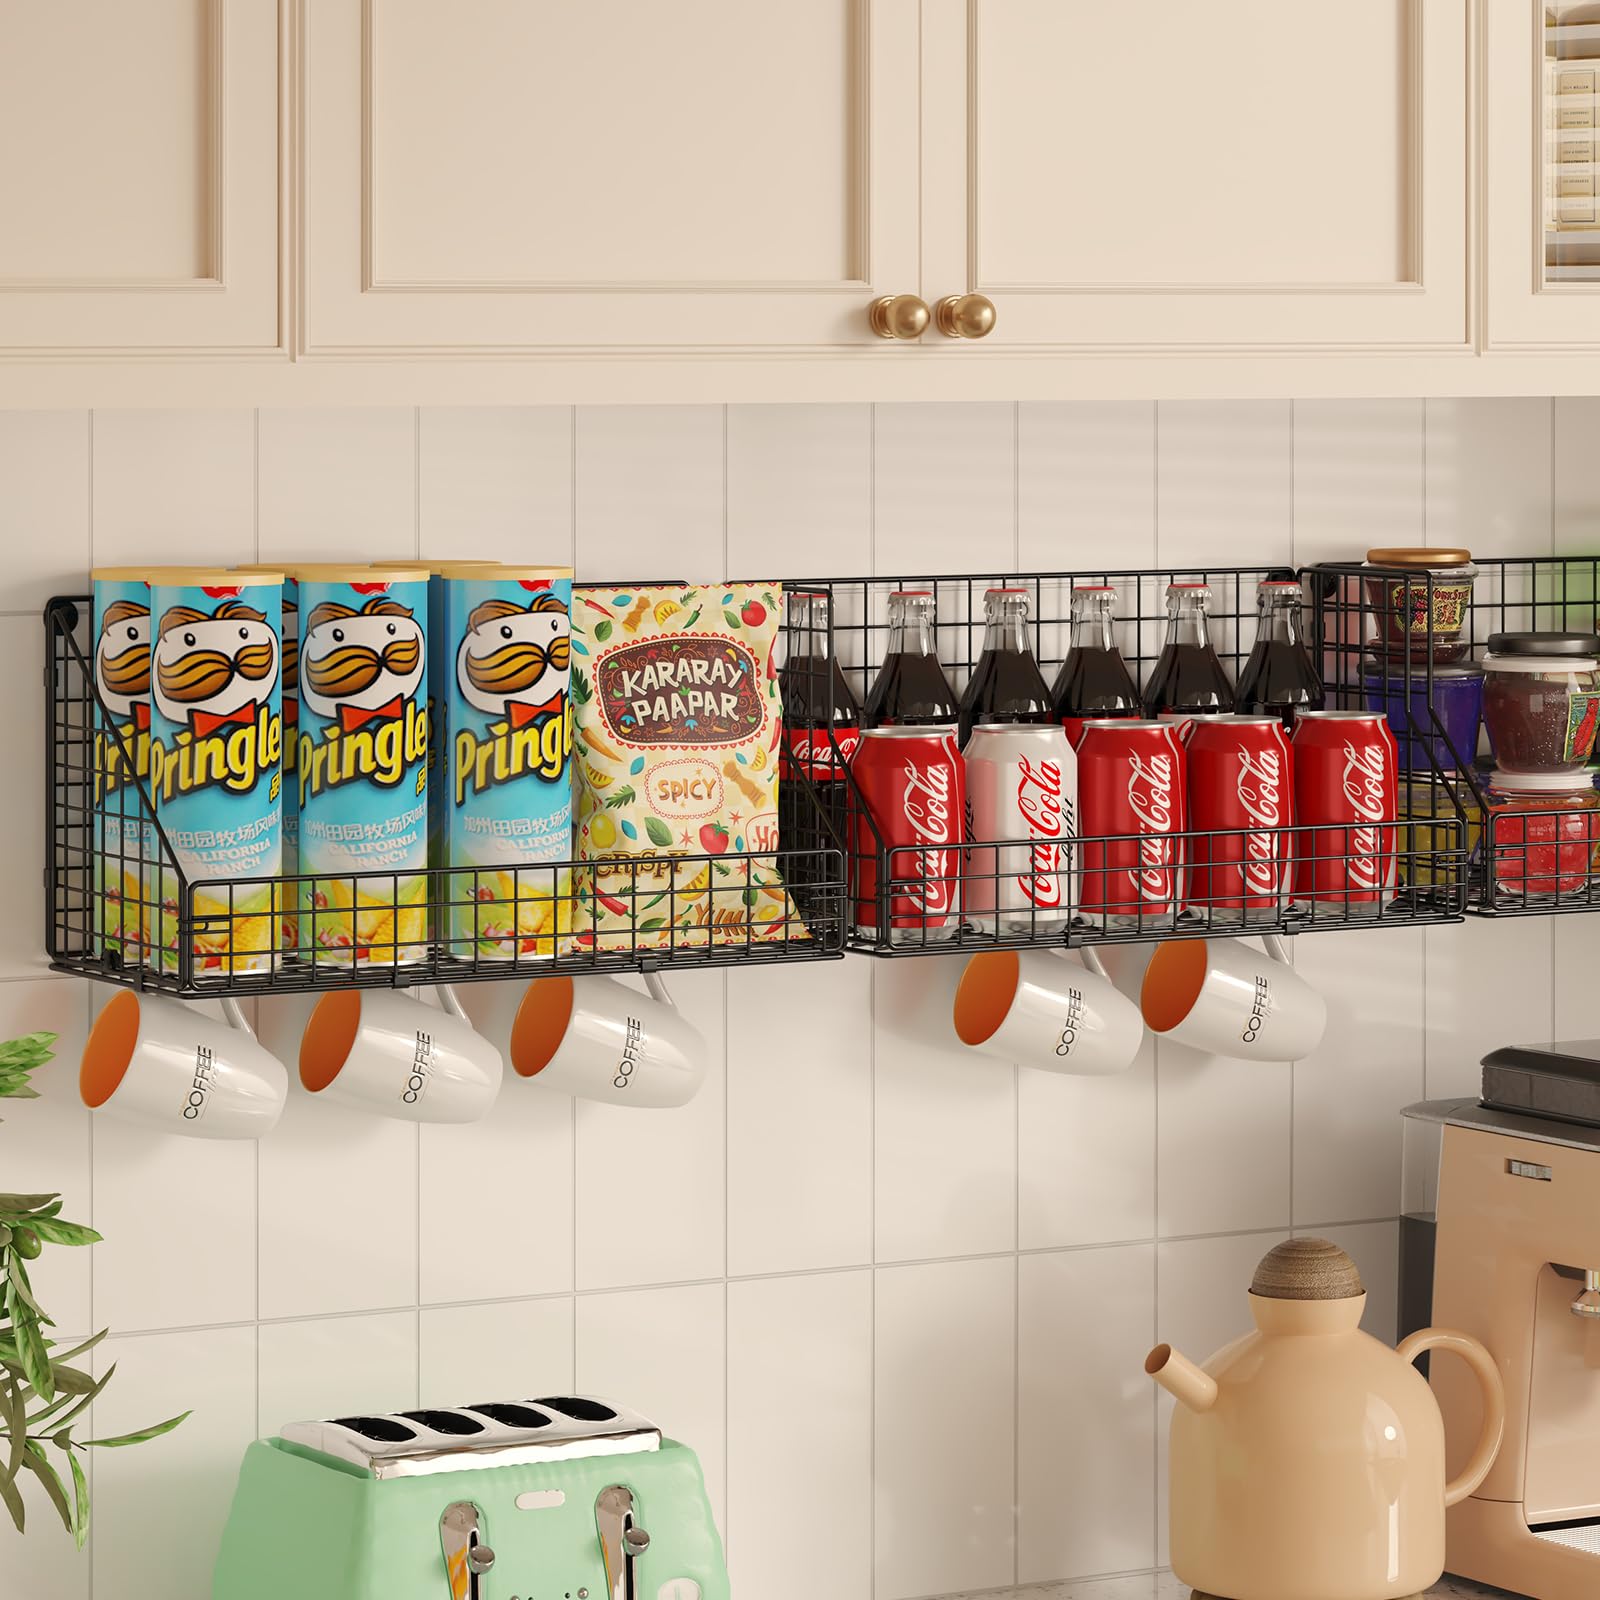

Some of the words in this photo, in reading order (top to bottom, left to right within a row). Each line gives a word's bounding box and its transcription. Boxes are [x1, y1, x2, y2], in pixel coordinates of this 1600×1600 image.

[621, 657, 743, 698] KARARAY
[630, 689, 740, 726] PAAPAR
[150, 704, 281, 814] Pringle
[300, 700, 427, 809] Pringle
[656, 778, 717, 803] SPICY
[176, 838, 271, 864] CALIFORNIA
[206, 855, 261, 876] RANCH
[328, 831, 417, 856] CALIFORNIA
[354, 848, 408, 867] RANCH
[1055, 988, 1082, 1056] COFFEE
[1242, 975, 1268, 1043] COFFEE
[402, 1030, 431, 1104] COFFEE
[613, 1016, 641, 1089] COFFEE
[183, 1044, 212, 1120] COFFEE
